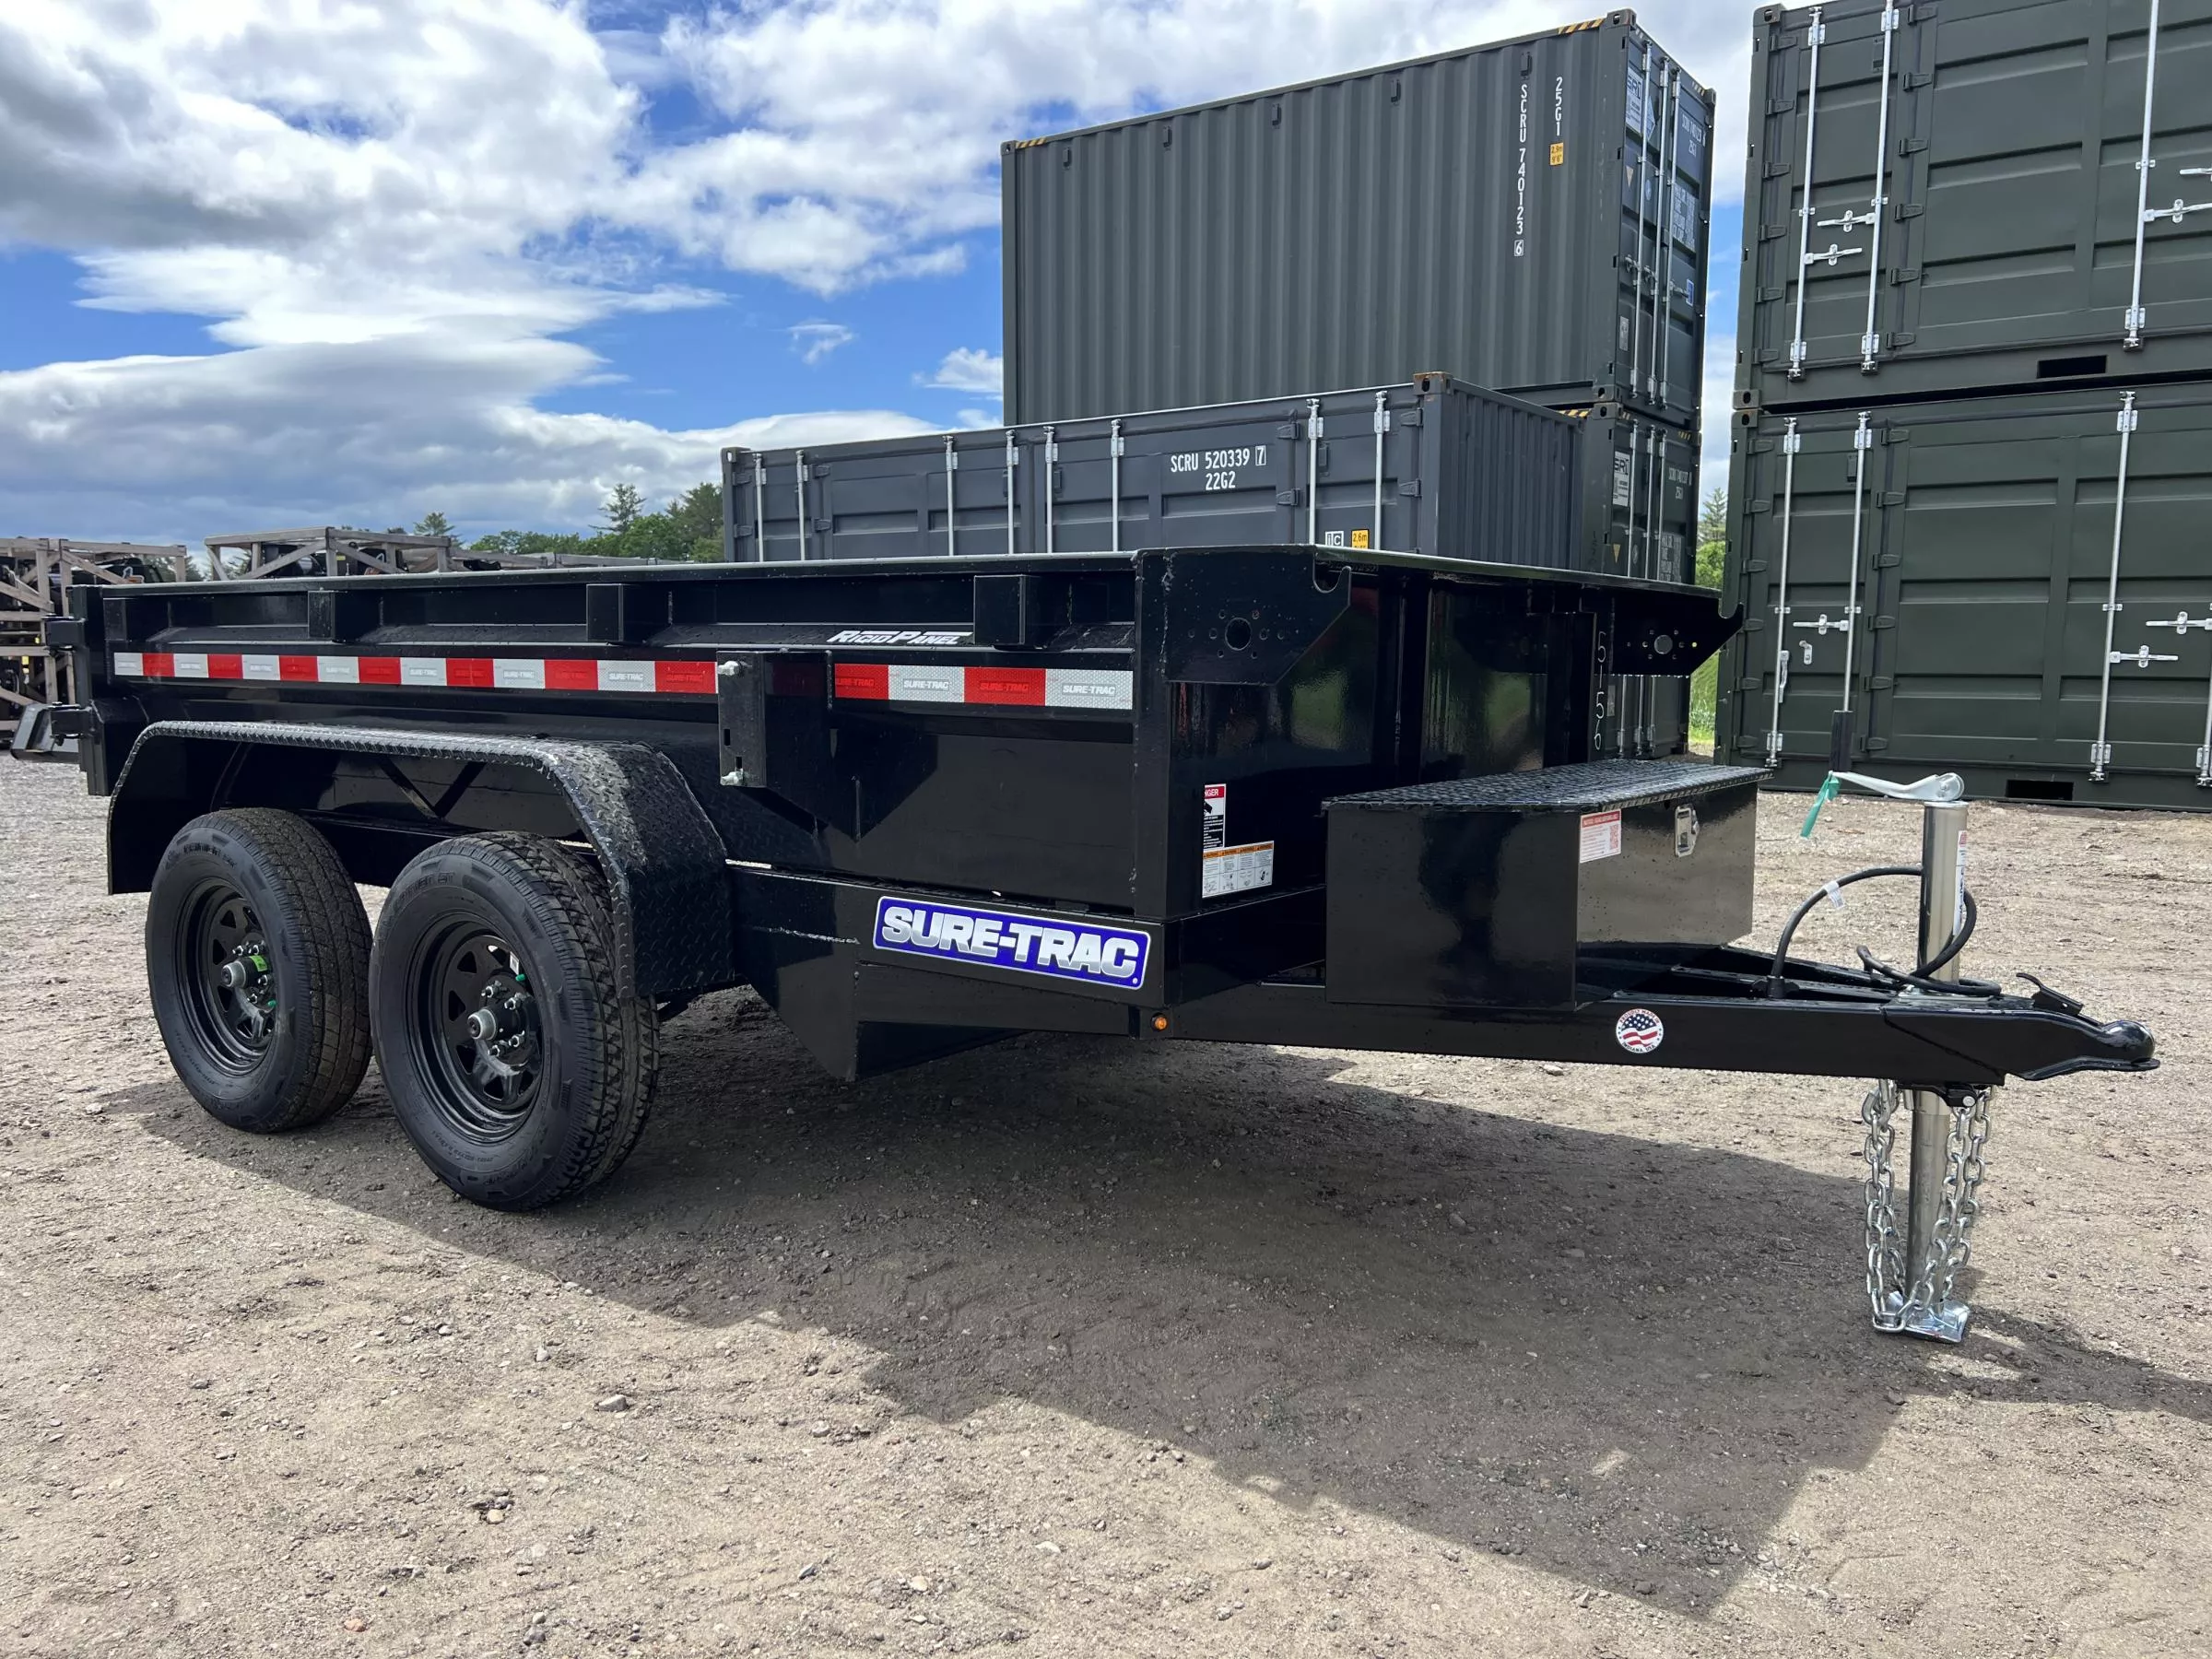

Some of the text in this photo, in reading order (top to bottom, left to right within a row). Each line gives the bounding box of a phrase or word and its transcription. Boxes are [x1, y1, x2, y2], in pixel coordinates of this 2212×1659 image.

[1555, 76, 1563, 136] 25G1
[1515, 84, 1528, 255] SCRU 740123 6
[1170, 446, 1265, 473] SCRU 520339 7
[1206, 471, 1236, 490] 22G2
[903, 679, 949, 690] SURE-TRAC
[980, 682, 1029, 692] SURE-TRAC
[1063, 685, 1116, 695] SURE-TRAC
[881, 906, 1139, 978] SURE-TRAC
